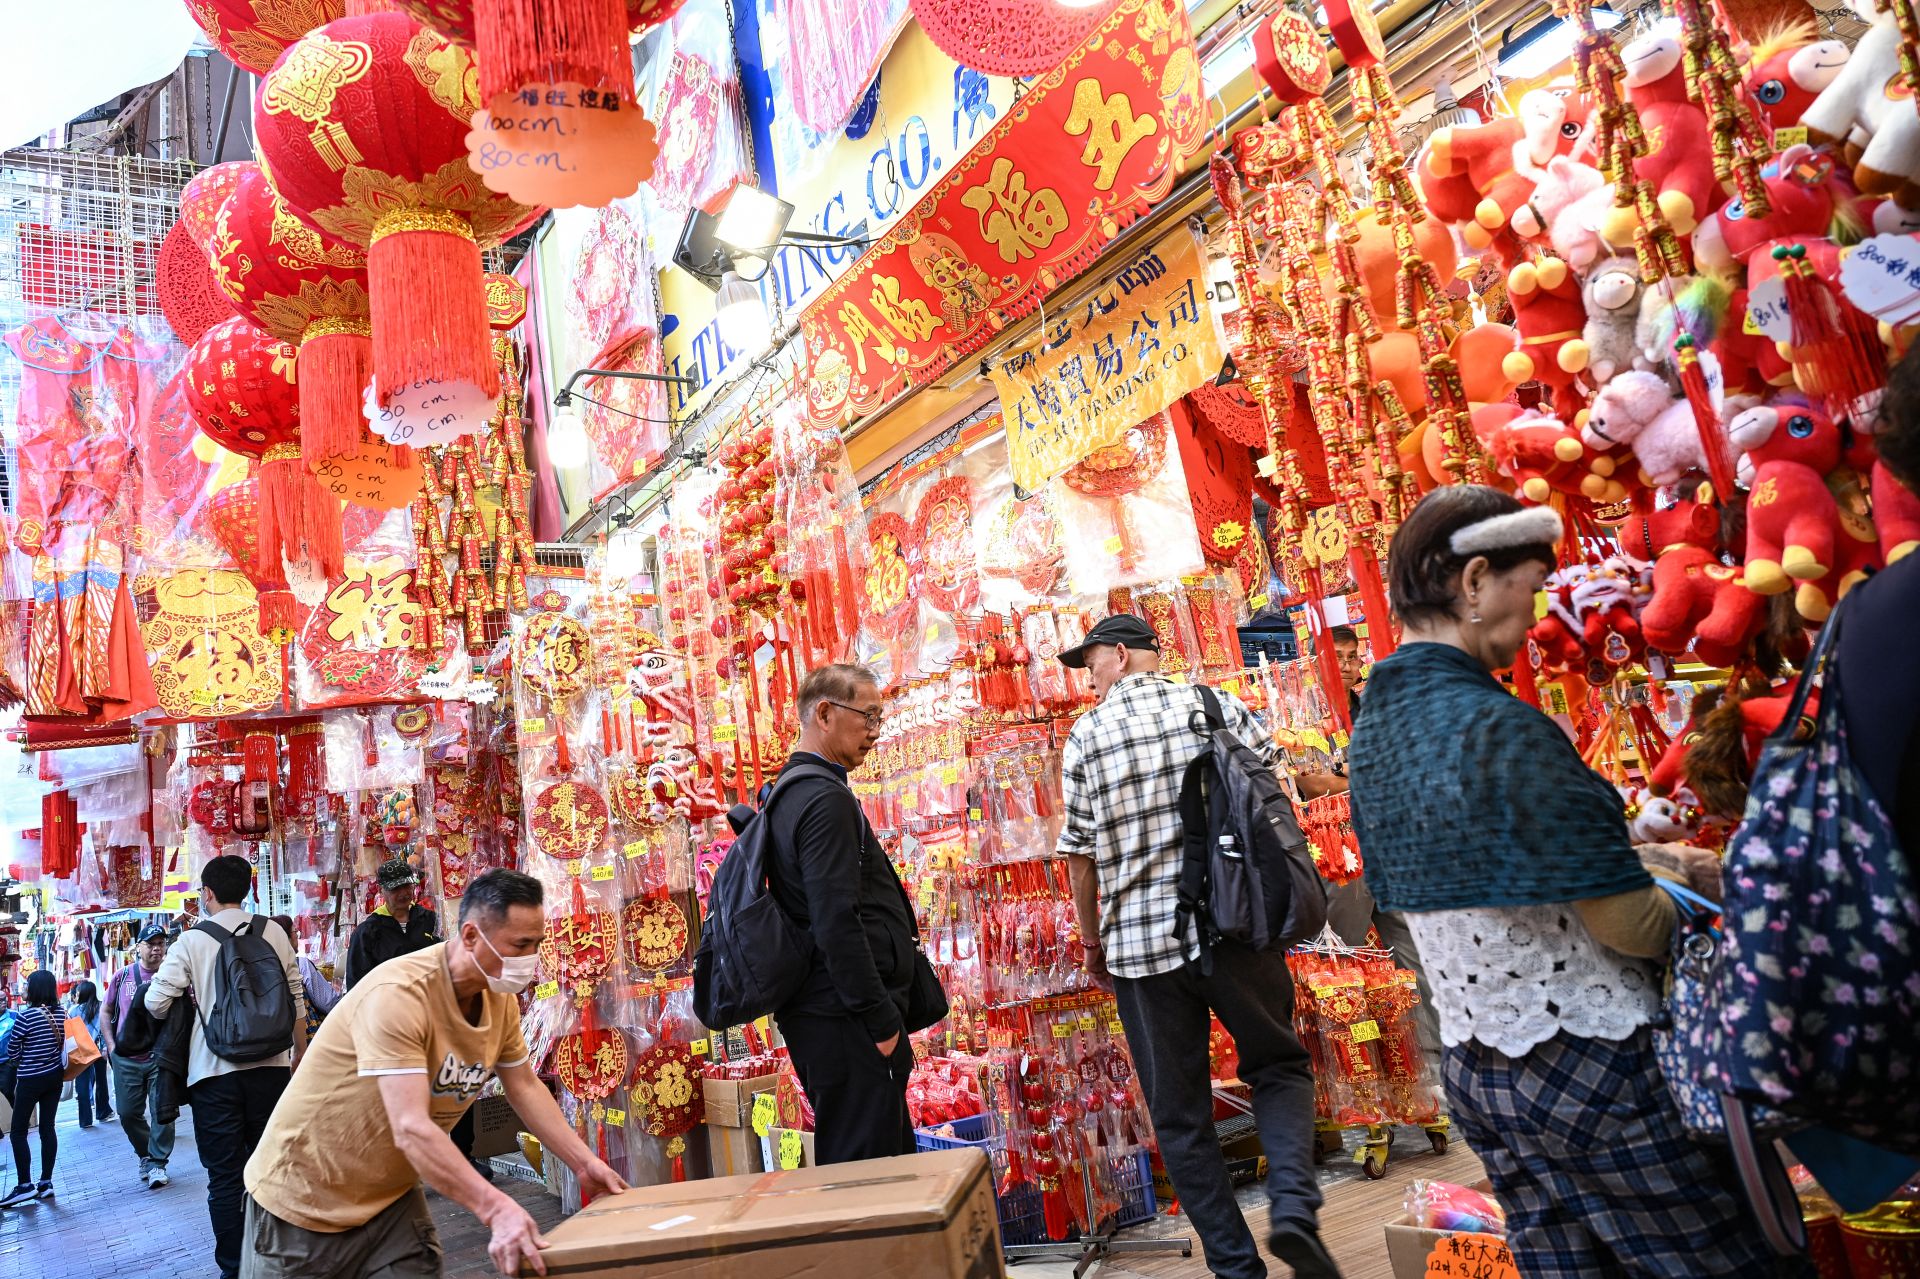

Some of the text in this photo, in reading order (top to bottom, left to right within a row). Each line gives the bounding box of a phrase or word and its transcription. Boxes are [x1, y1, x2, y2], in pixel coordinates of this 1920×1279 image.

[1080, 363, 1158, 421] TRADING
[1162, 343, 1193, 370] CO.
[317, 460, 343, 478] 80
[330, 480, 348, 494] 60
[1153, 606, 1178, 661] 大吉大利
